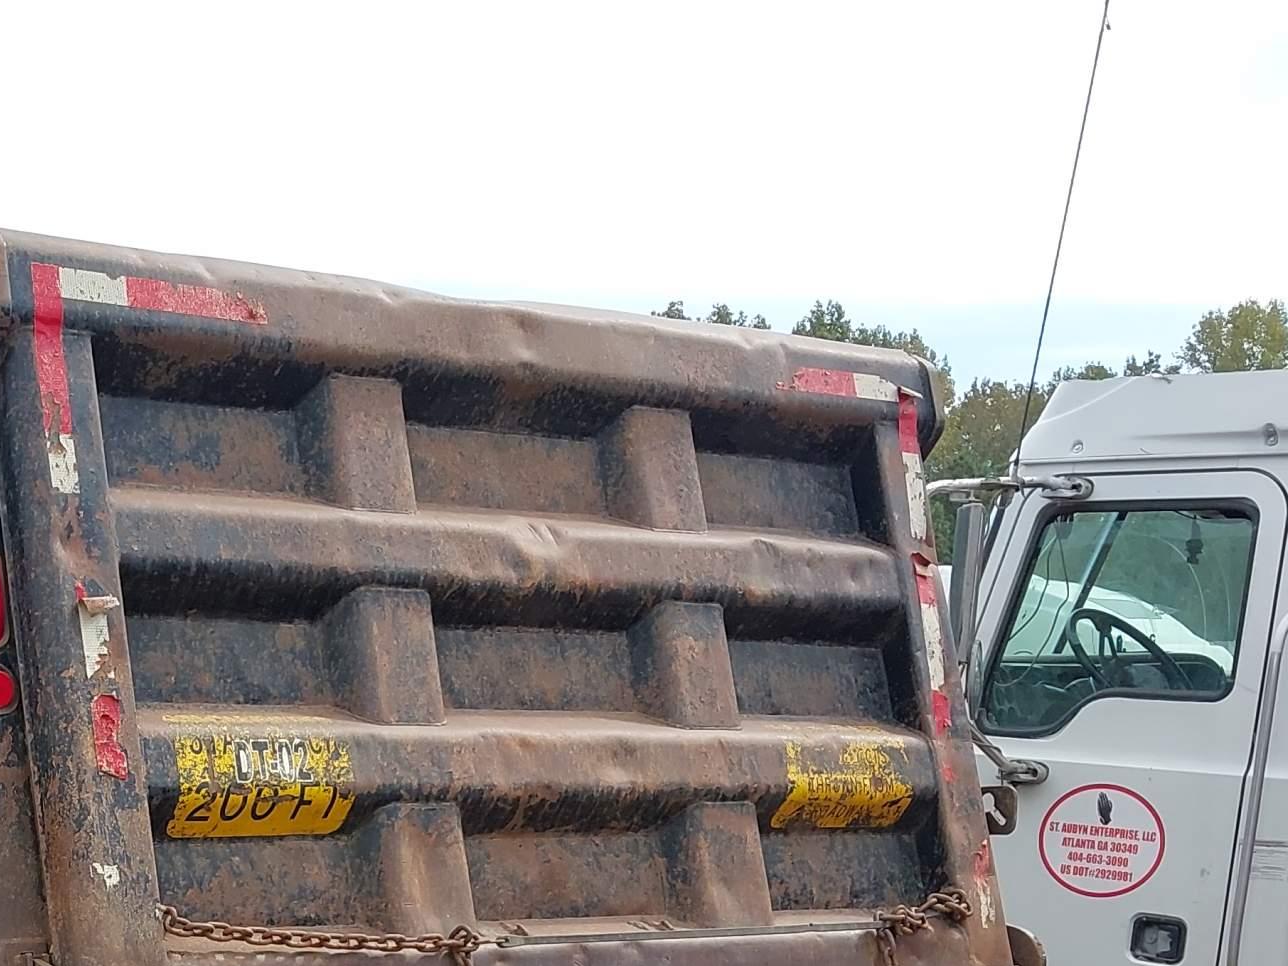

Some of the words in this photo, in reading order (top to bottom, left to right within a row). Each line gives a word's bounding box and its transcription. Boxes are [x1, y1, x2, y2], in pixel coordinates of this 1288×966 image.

[1049, 821, 1060, 832] ST.
[1142, 831, 1157, 842] LLC
[1062, 837, 1096, 850] ATLANTA
[1097, 840, 1108, 851] GA
[1060, 864, 1071, 875] US
